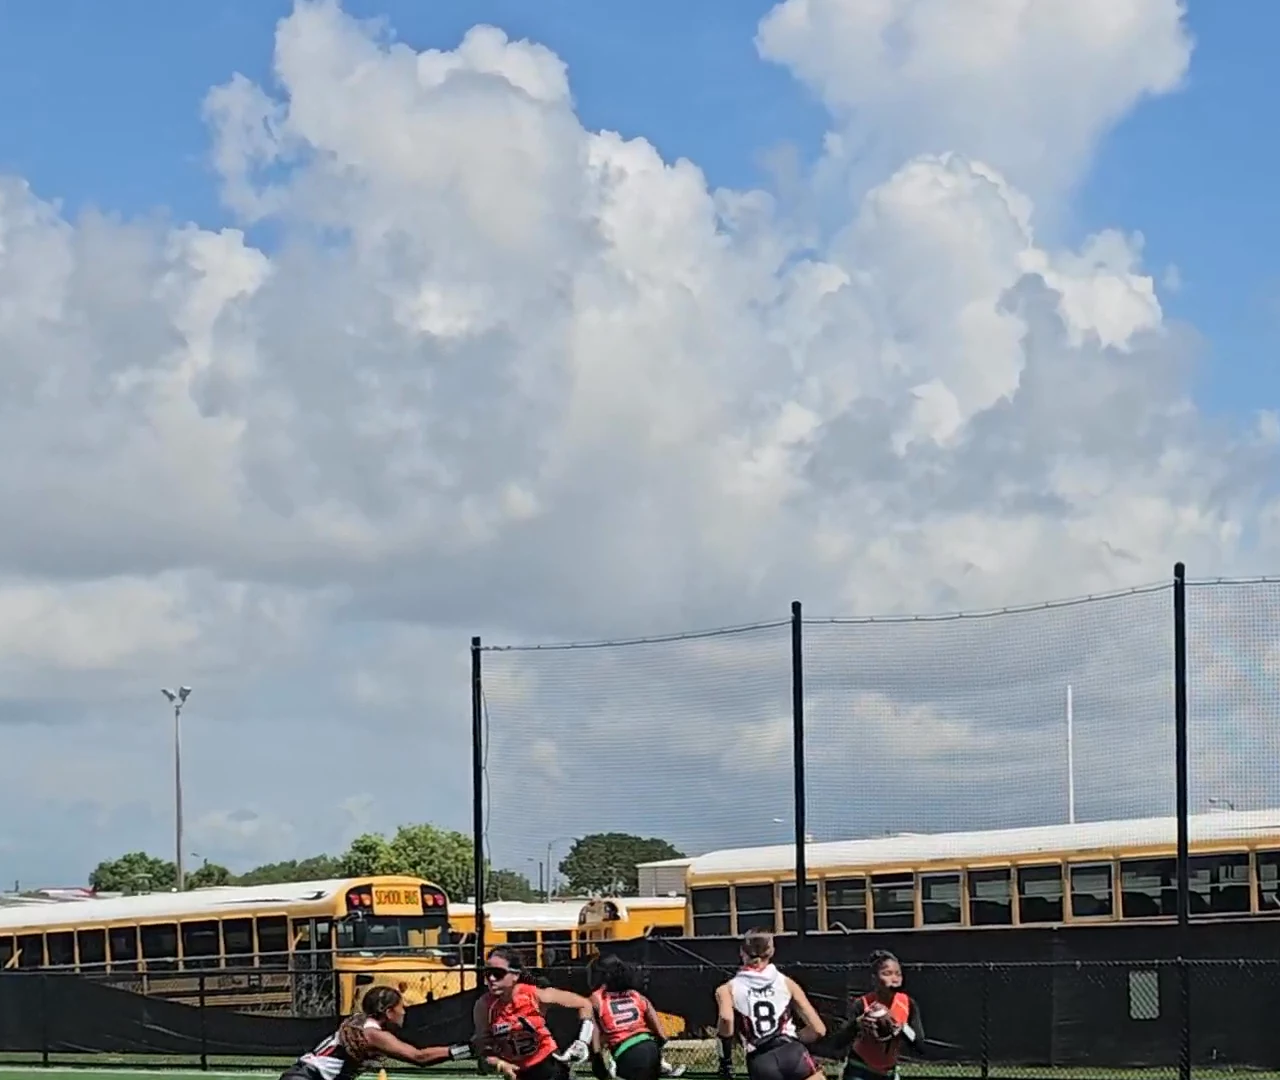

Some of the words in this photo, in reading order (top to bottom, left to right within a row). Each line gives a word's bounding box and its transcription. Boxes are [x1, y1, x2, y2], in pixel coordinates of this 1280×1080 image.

[375, 890, 403, 905] SCHOOL
[404, 890, 419, 905] BUS
[610, 998, 639, 1026] 5
[753, 1000, 776, 1034] 8
